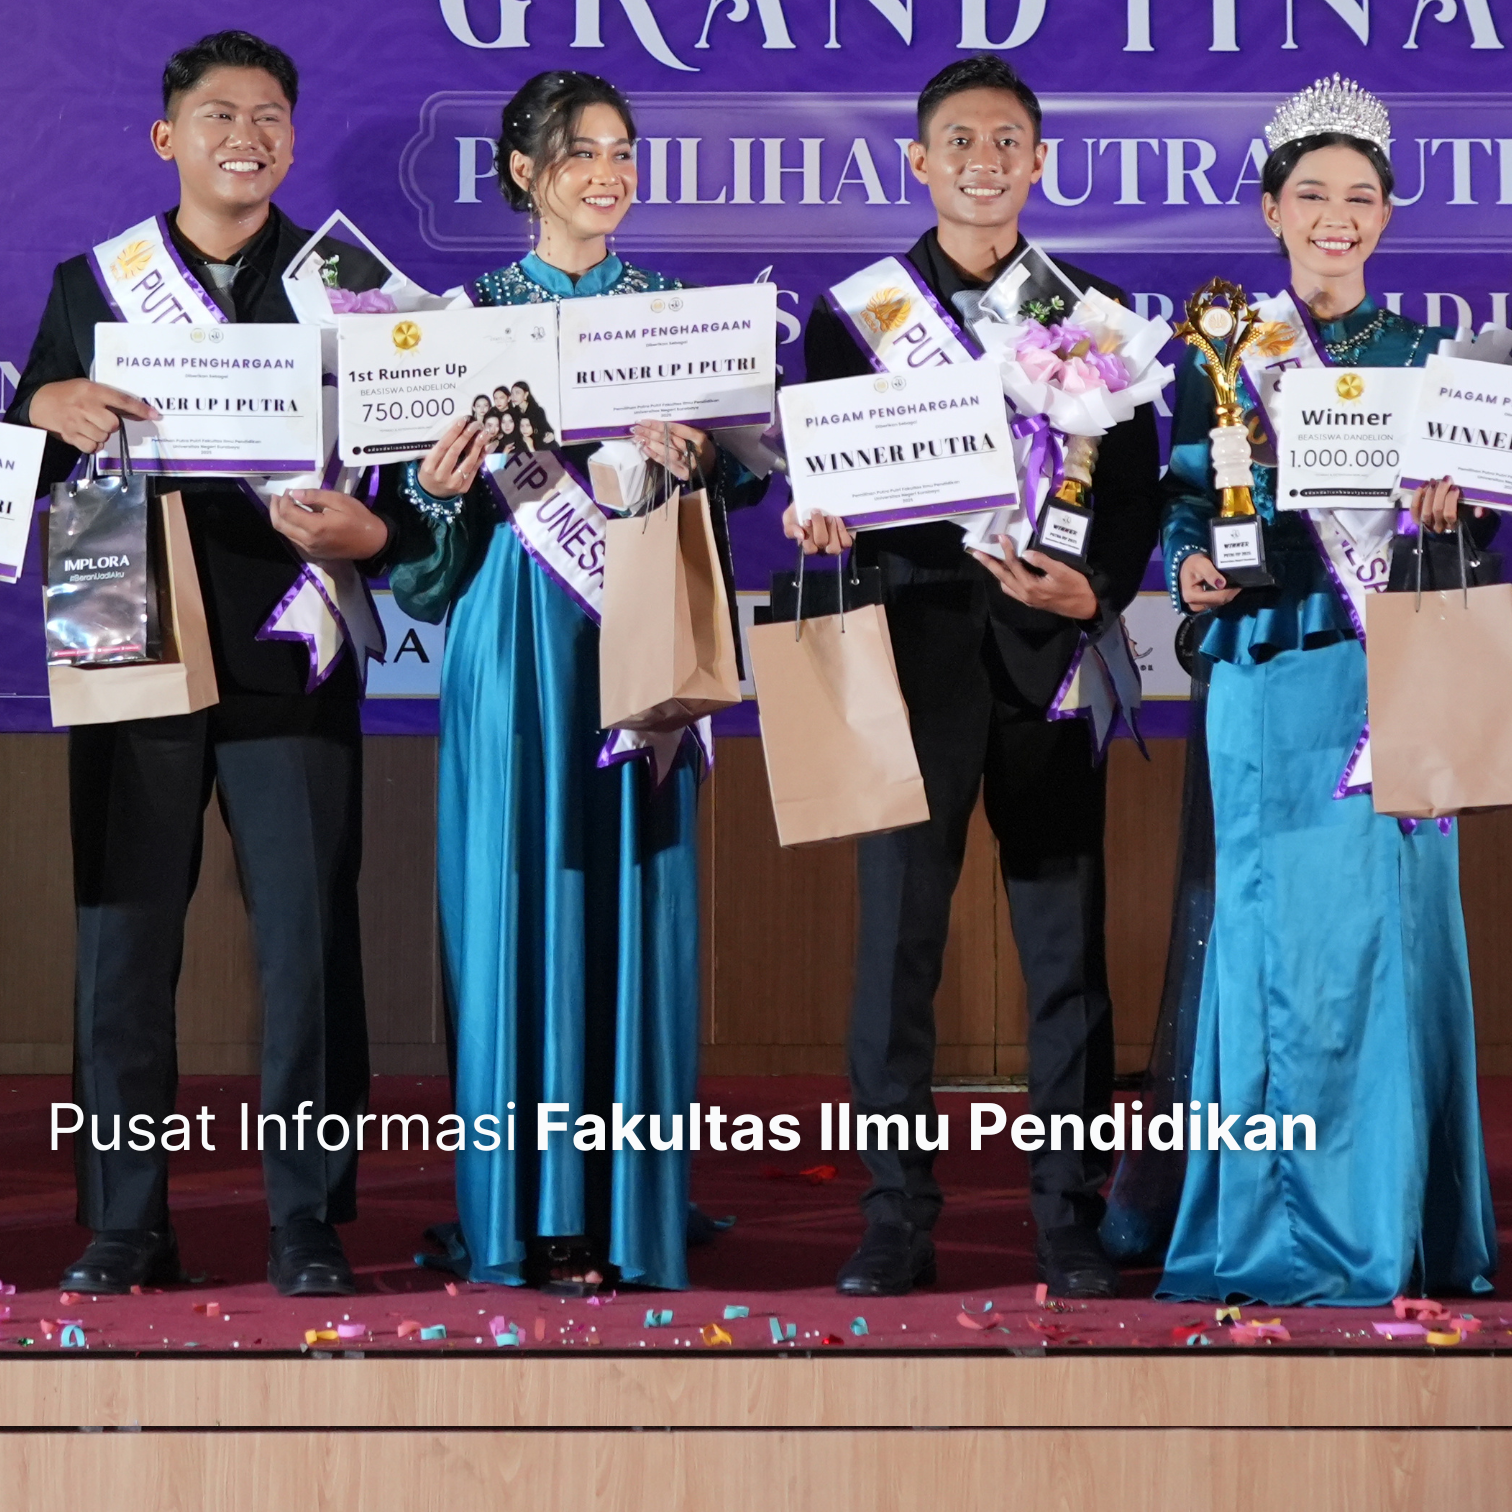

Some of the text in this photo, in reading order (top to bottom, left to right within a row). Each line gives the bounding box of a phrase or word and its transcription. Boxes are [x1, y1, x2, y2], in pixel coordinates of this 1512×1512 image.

[579, 320, 752, 343] PIAGAM PENGHARGAAN
[117, 356, 295, 369] PIAGAM PENGHARGAAN
[577, 365, 651, 384] RUNNER
[658, 362, 681, 377] UP
[700, 357, 756, 374] PUTRI
[348, 363, 468, 383] 1st Runner Up
[360, 383, 456, 396] BEASISWA DANDELION
[1439, 387, 1498, 404] PIAGAM
[196, 397, 218, 411] UP
[237, 398, 298, 412] PUTRA
[362, 397, 455, 423] 750.000
[806, 396, 980, 427] PIAGAM PENGHARGAAN
[1302, 409, 1392, 425] Winner
[806, 433, 996, 473] WINNER PUTRA
[1290, 449, 1399, 468] 1.000.000
[504, 451, 548, 490] FIP
[1053, 524, 1078, 535] WINNER
[64, 554, 130, 572] IMPLORA
